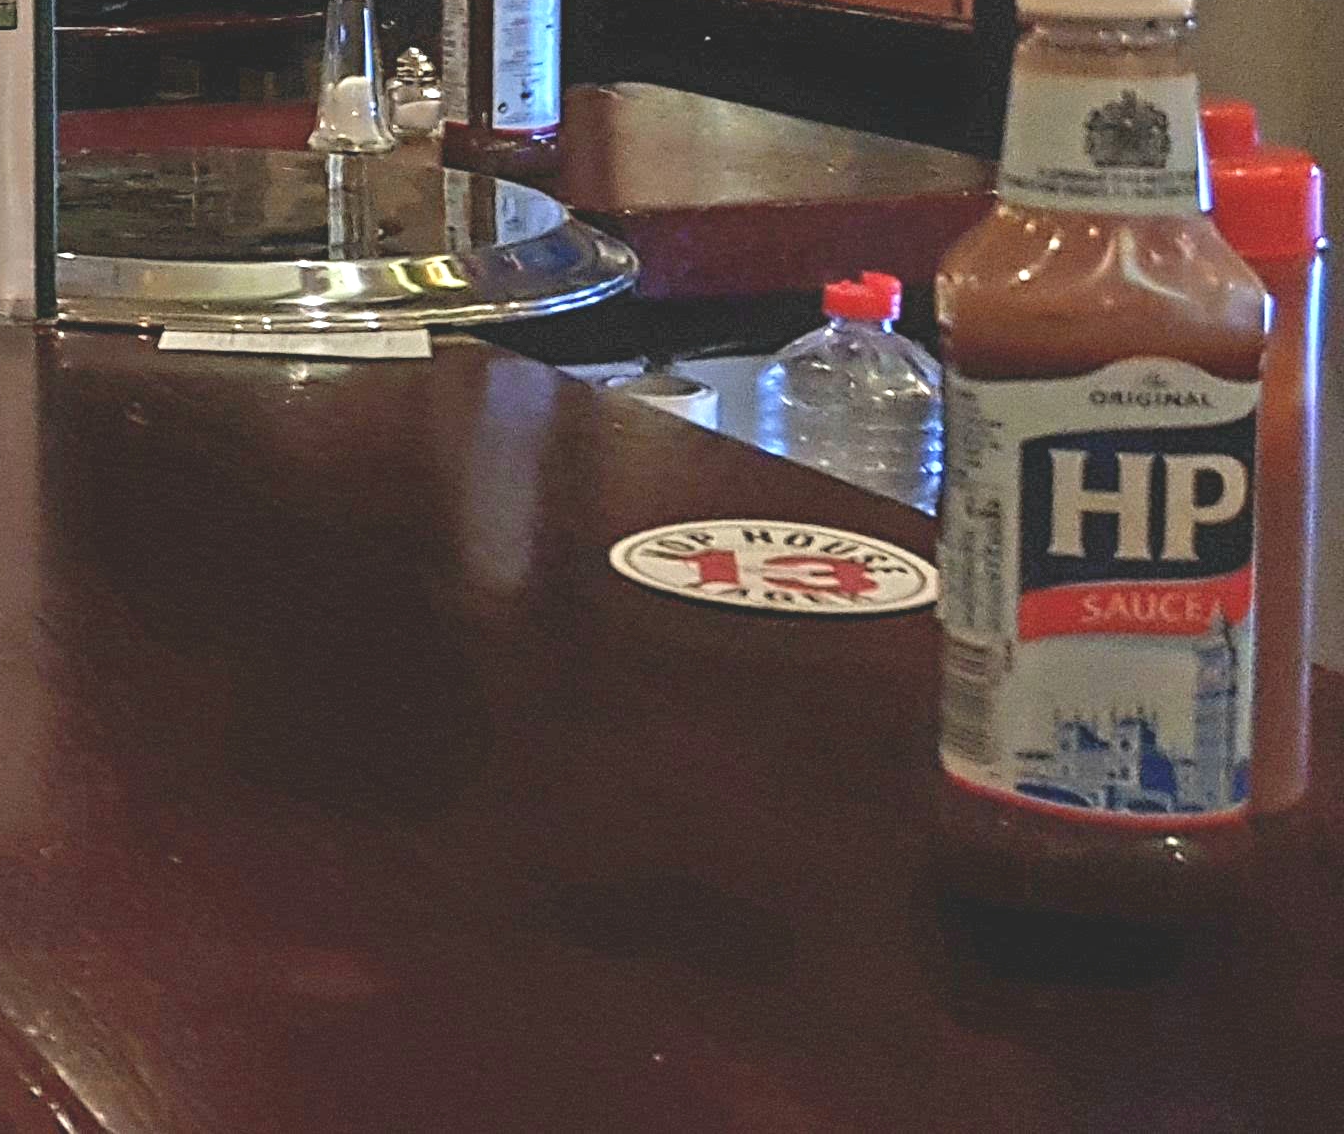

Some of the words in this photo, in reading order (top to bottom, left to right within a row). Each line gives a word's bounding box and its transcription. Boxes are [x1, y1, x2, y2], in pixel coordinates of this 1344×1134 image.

[1088, 389, 1216, 409] ORIGINAL
[1047, 449, 1248, 561] HP
[680, 549, 879, 594] 13
[1080, 592, 1202, 623] SAUCE
